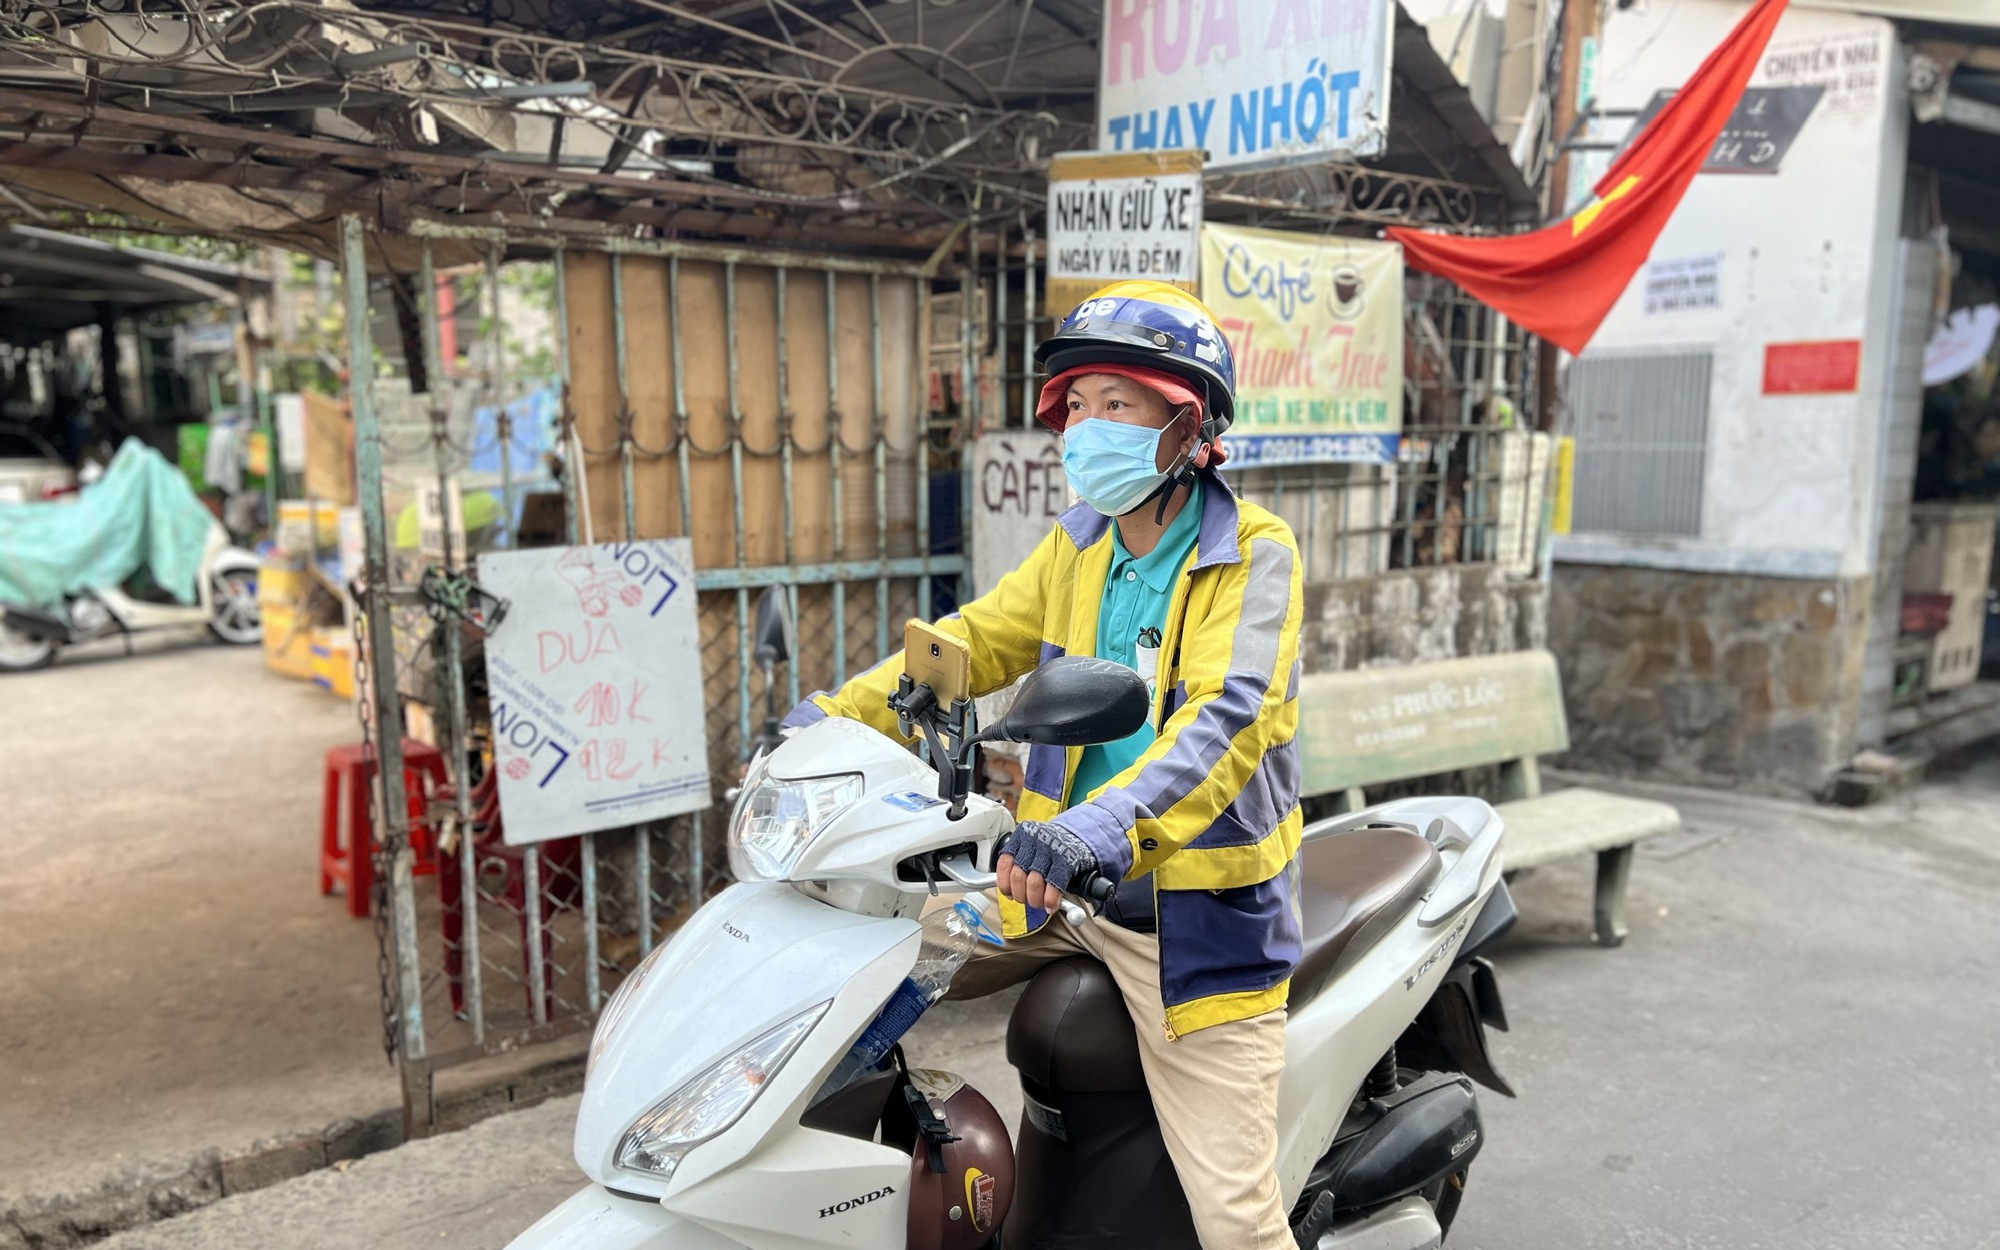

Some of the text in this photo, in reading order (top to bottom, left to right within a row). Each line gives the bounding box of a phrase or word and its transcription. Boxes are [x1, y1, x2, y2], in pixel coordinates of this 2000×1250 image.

[1108, 58, 1360, 156] THAY NHỚT
[1056, 178, 1191, 240] NHẬN GIỮ XE
[1109, 242, 1131, 273] VÀ
[1138, 241, 1181, 274] ĐÊM
[1223, 243, 1316, 321] Café
[1075, 299, 1116, 321] be
[818, 1186, 896, 1219] HONDA
